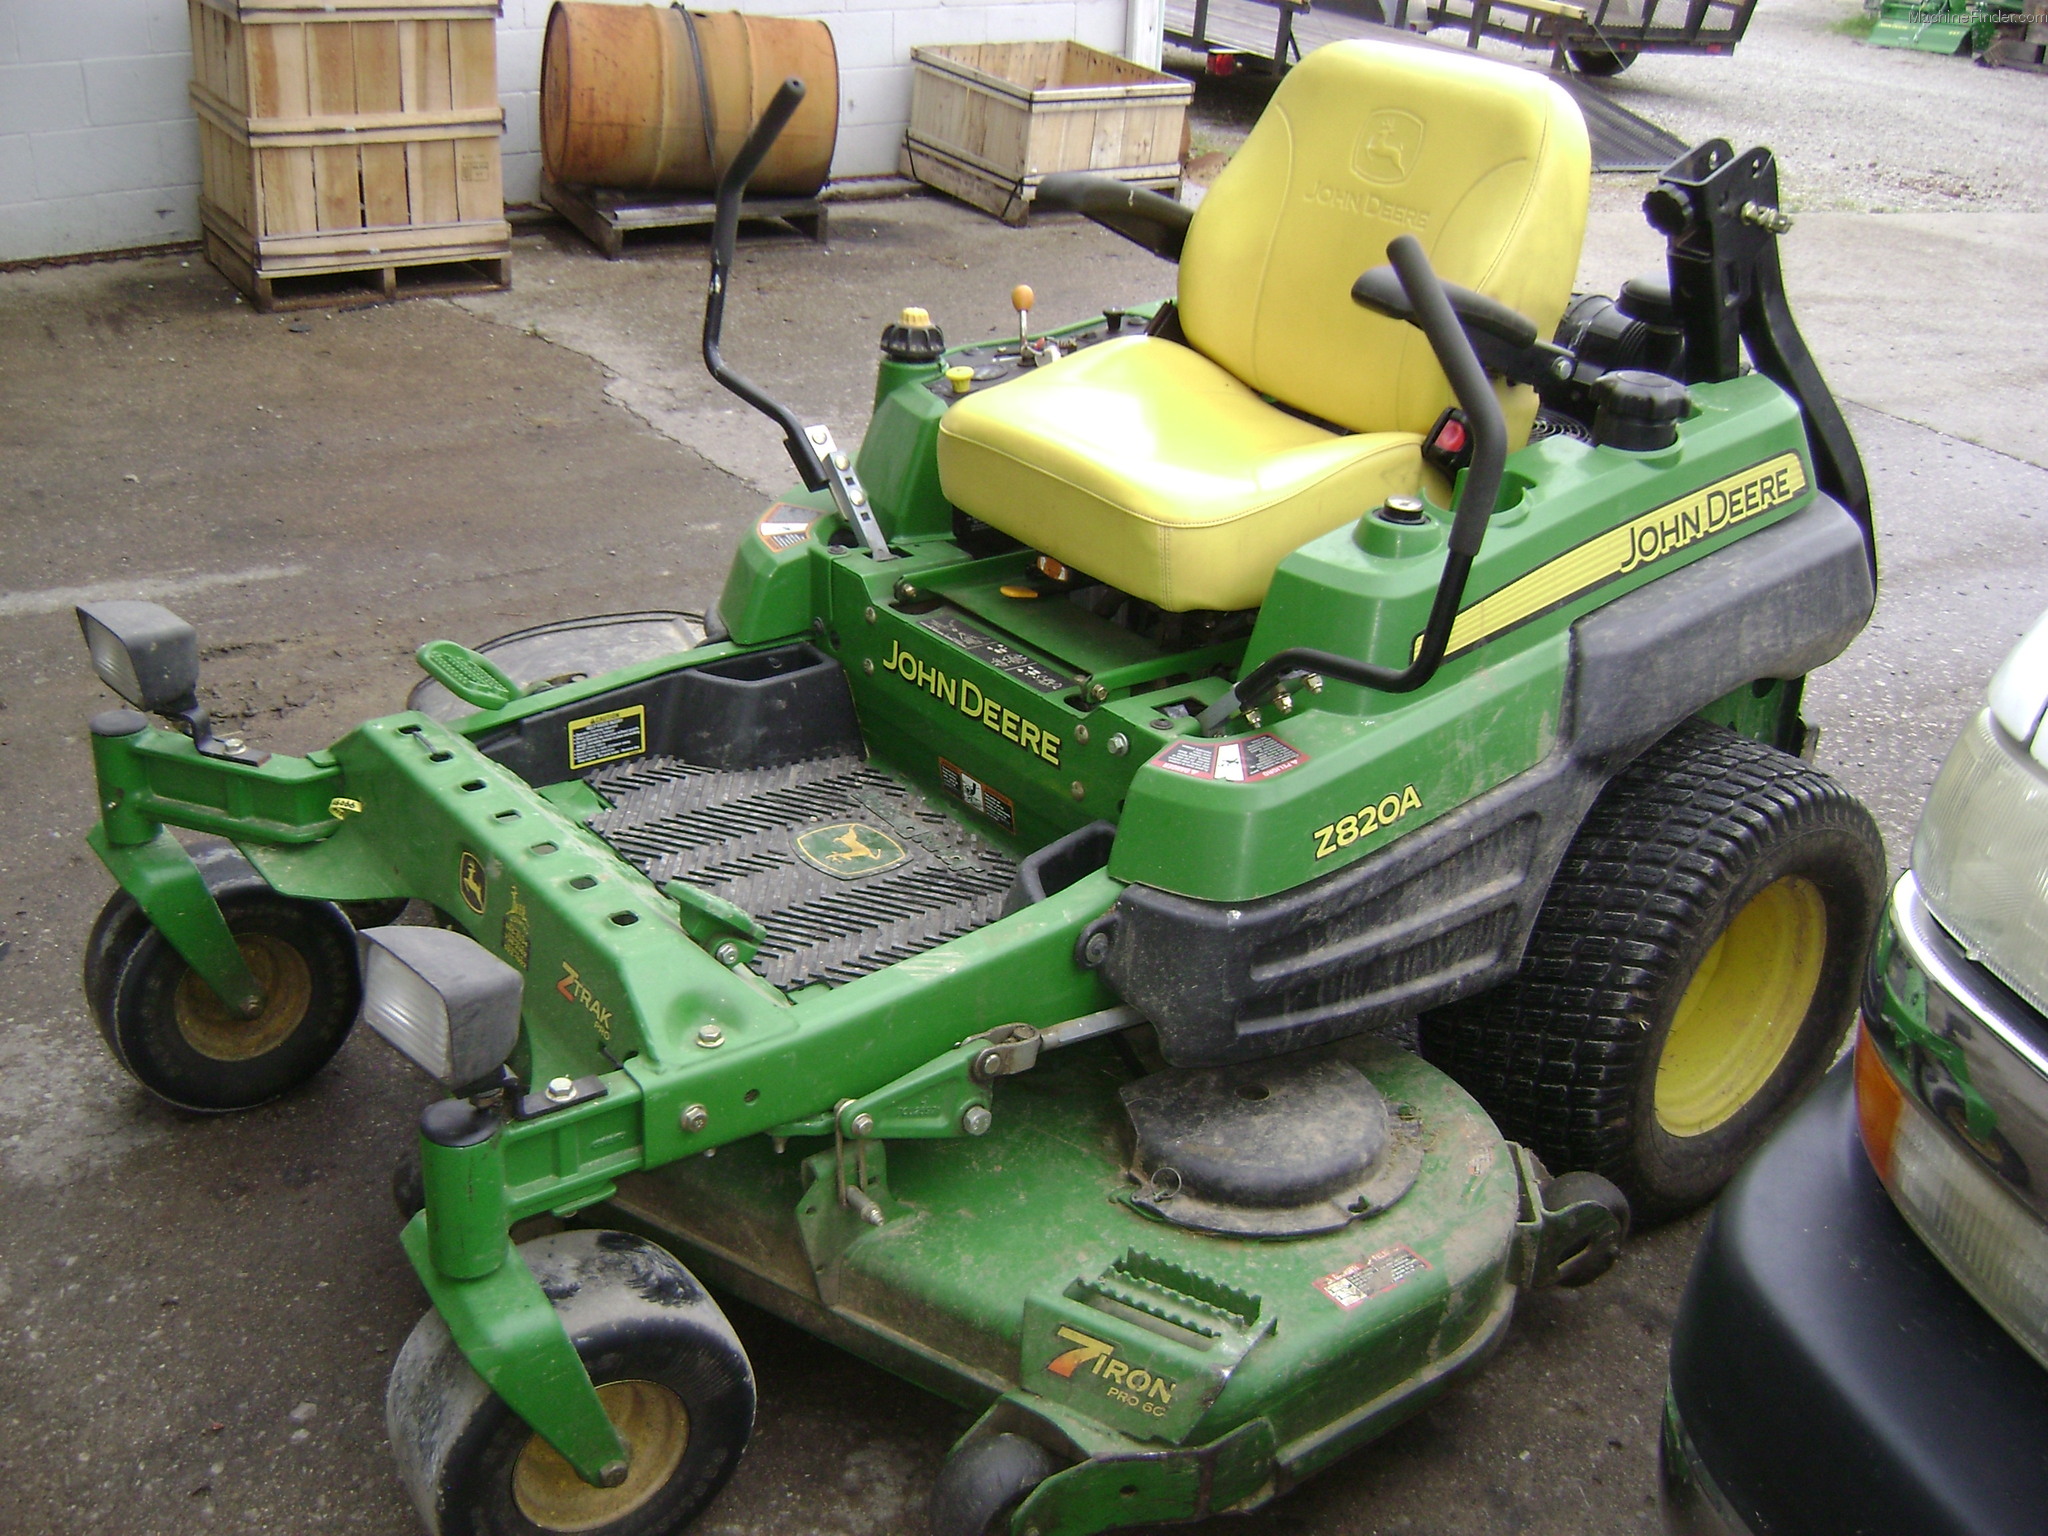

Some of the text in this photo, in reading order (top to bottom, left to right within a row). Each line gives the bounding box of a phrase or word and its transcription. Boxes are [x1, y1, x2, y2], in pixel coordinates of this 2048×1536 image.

[1303, 180, 1431, 232] JOHN DEERE
[1620, 467, 1793, 571] JOHN DEERE
[882, 639, 1062, 767] JOHN DEERE
[1313, 784, 1424, 861] Z820A
[1106, 1386, 1140, 1407] PRO
